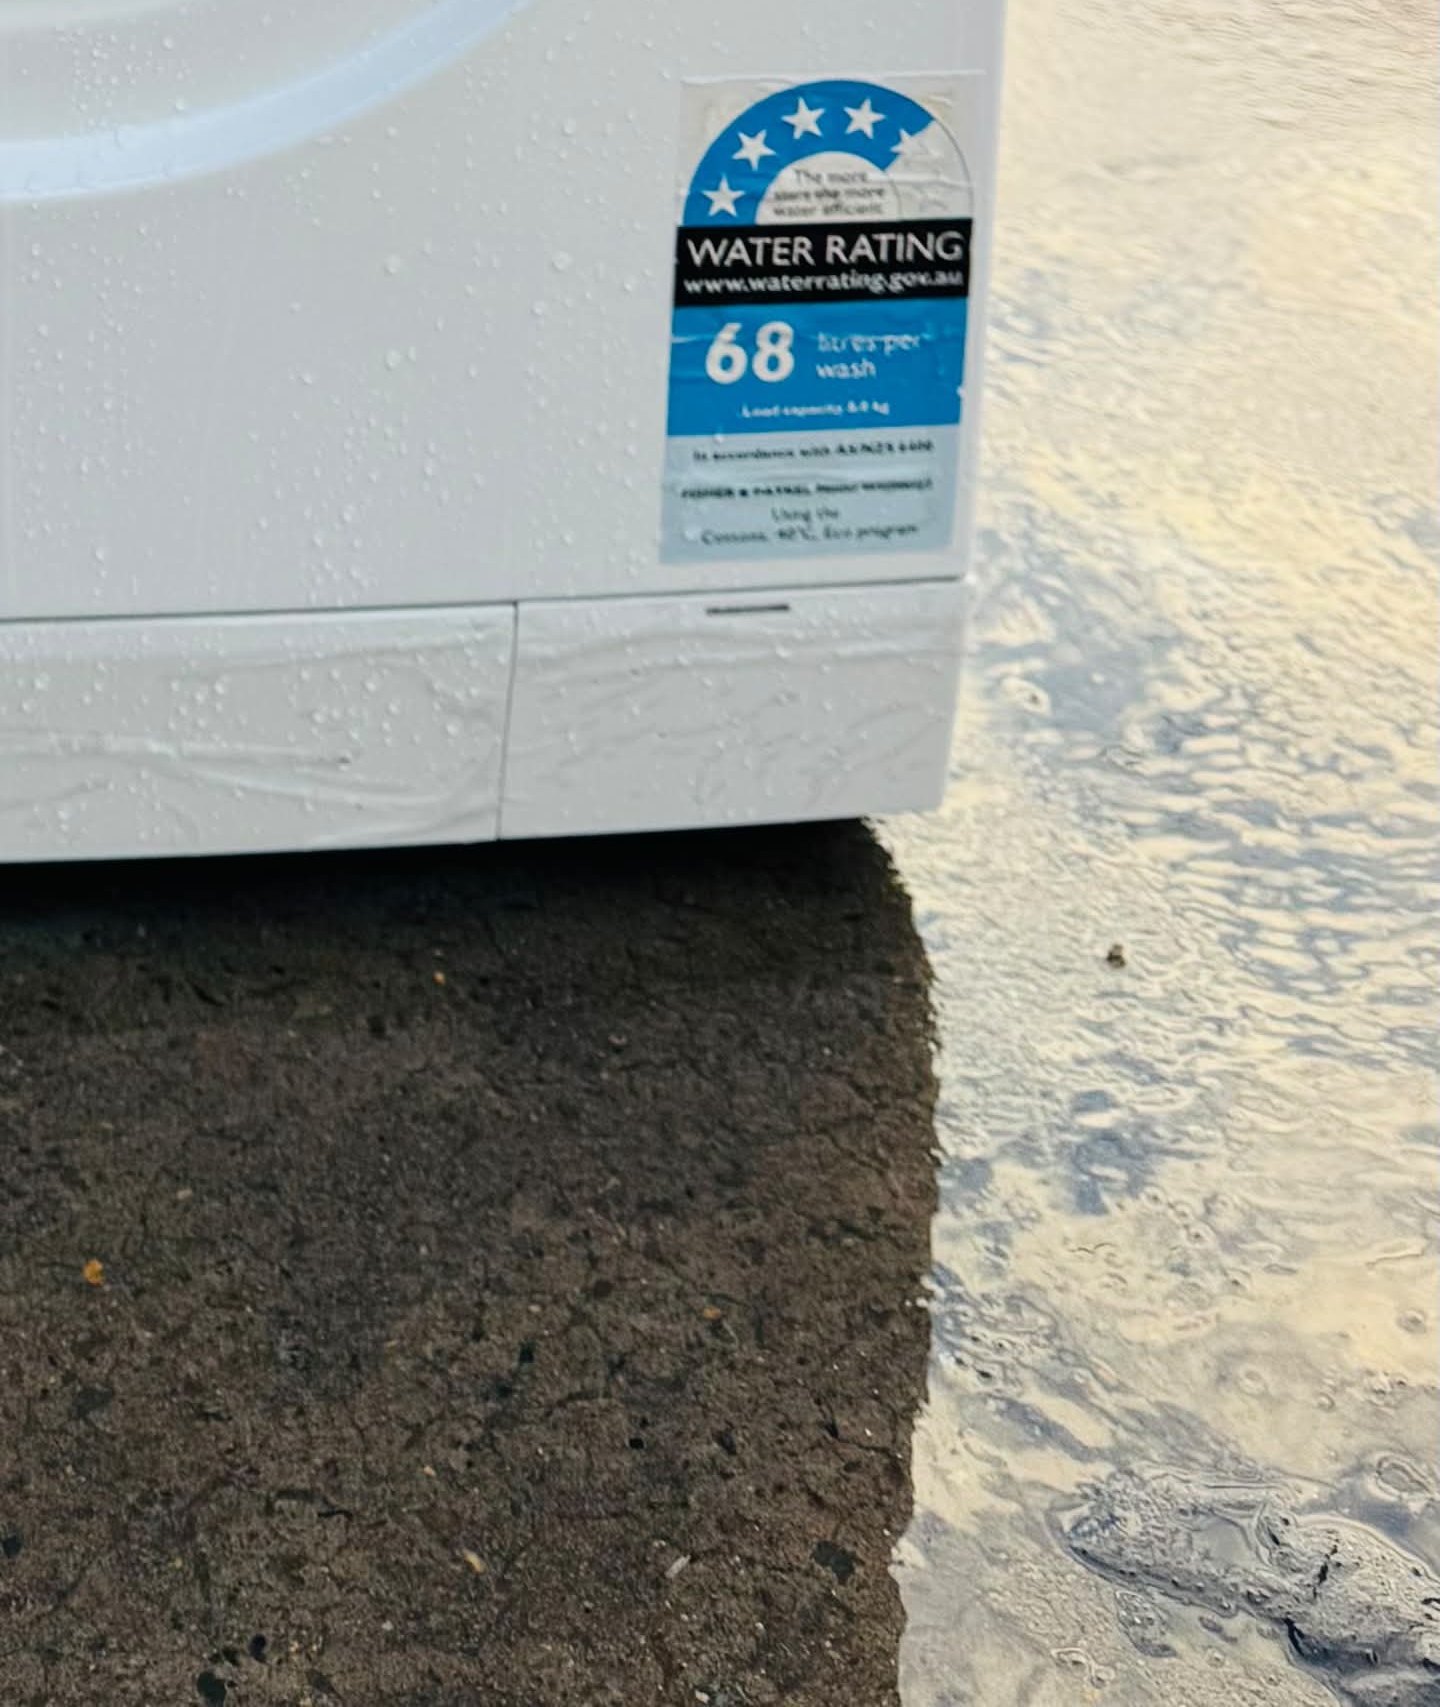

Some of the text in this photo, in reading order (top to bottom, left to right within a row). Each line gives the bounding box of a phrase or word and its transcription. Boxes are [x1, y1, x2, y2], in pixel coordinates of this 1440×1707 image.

[795, 170, 867, 184] The more
[815, 189, 840, 198] the
[845, 189, 884, 197] more
[774, 207, 817, 215] water
[688, 231, 963, 267] WATER RATING
[684, 268, 963, 293] www.waterrating.gov.au
[818, 333, 920, 355] litres per
[706, 321, 794, 384] 68
[816, 358, 876, 378] wash
[741, 406, 779, 418] Load
[783, 403, 842, 417] capacity
[772, 507, 810, 522] Using
[857, 525, 918, 538] program
